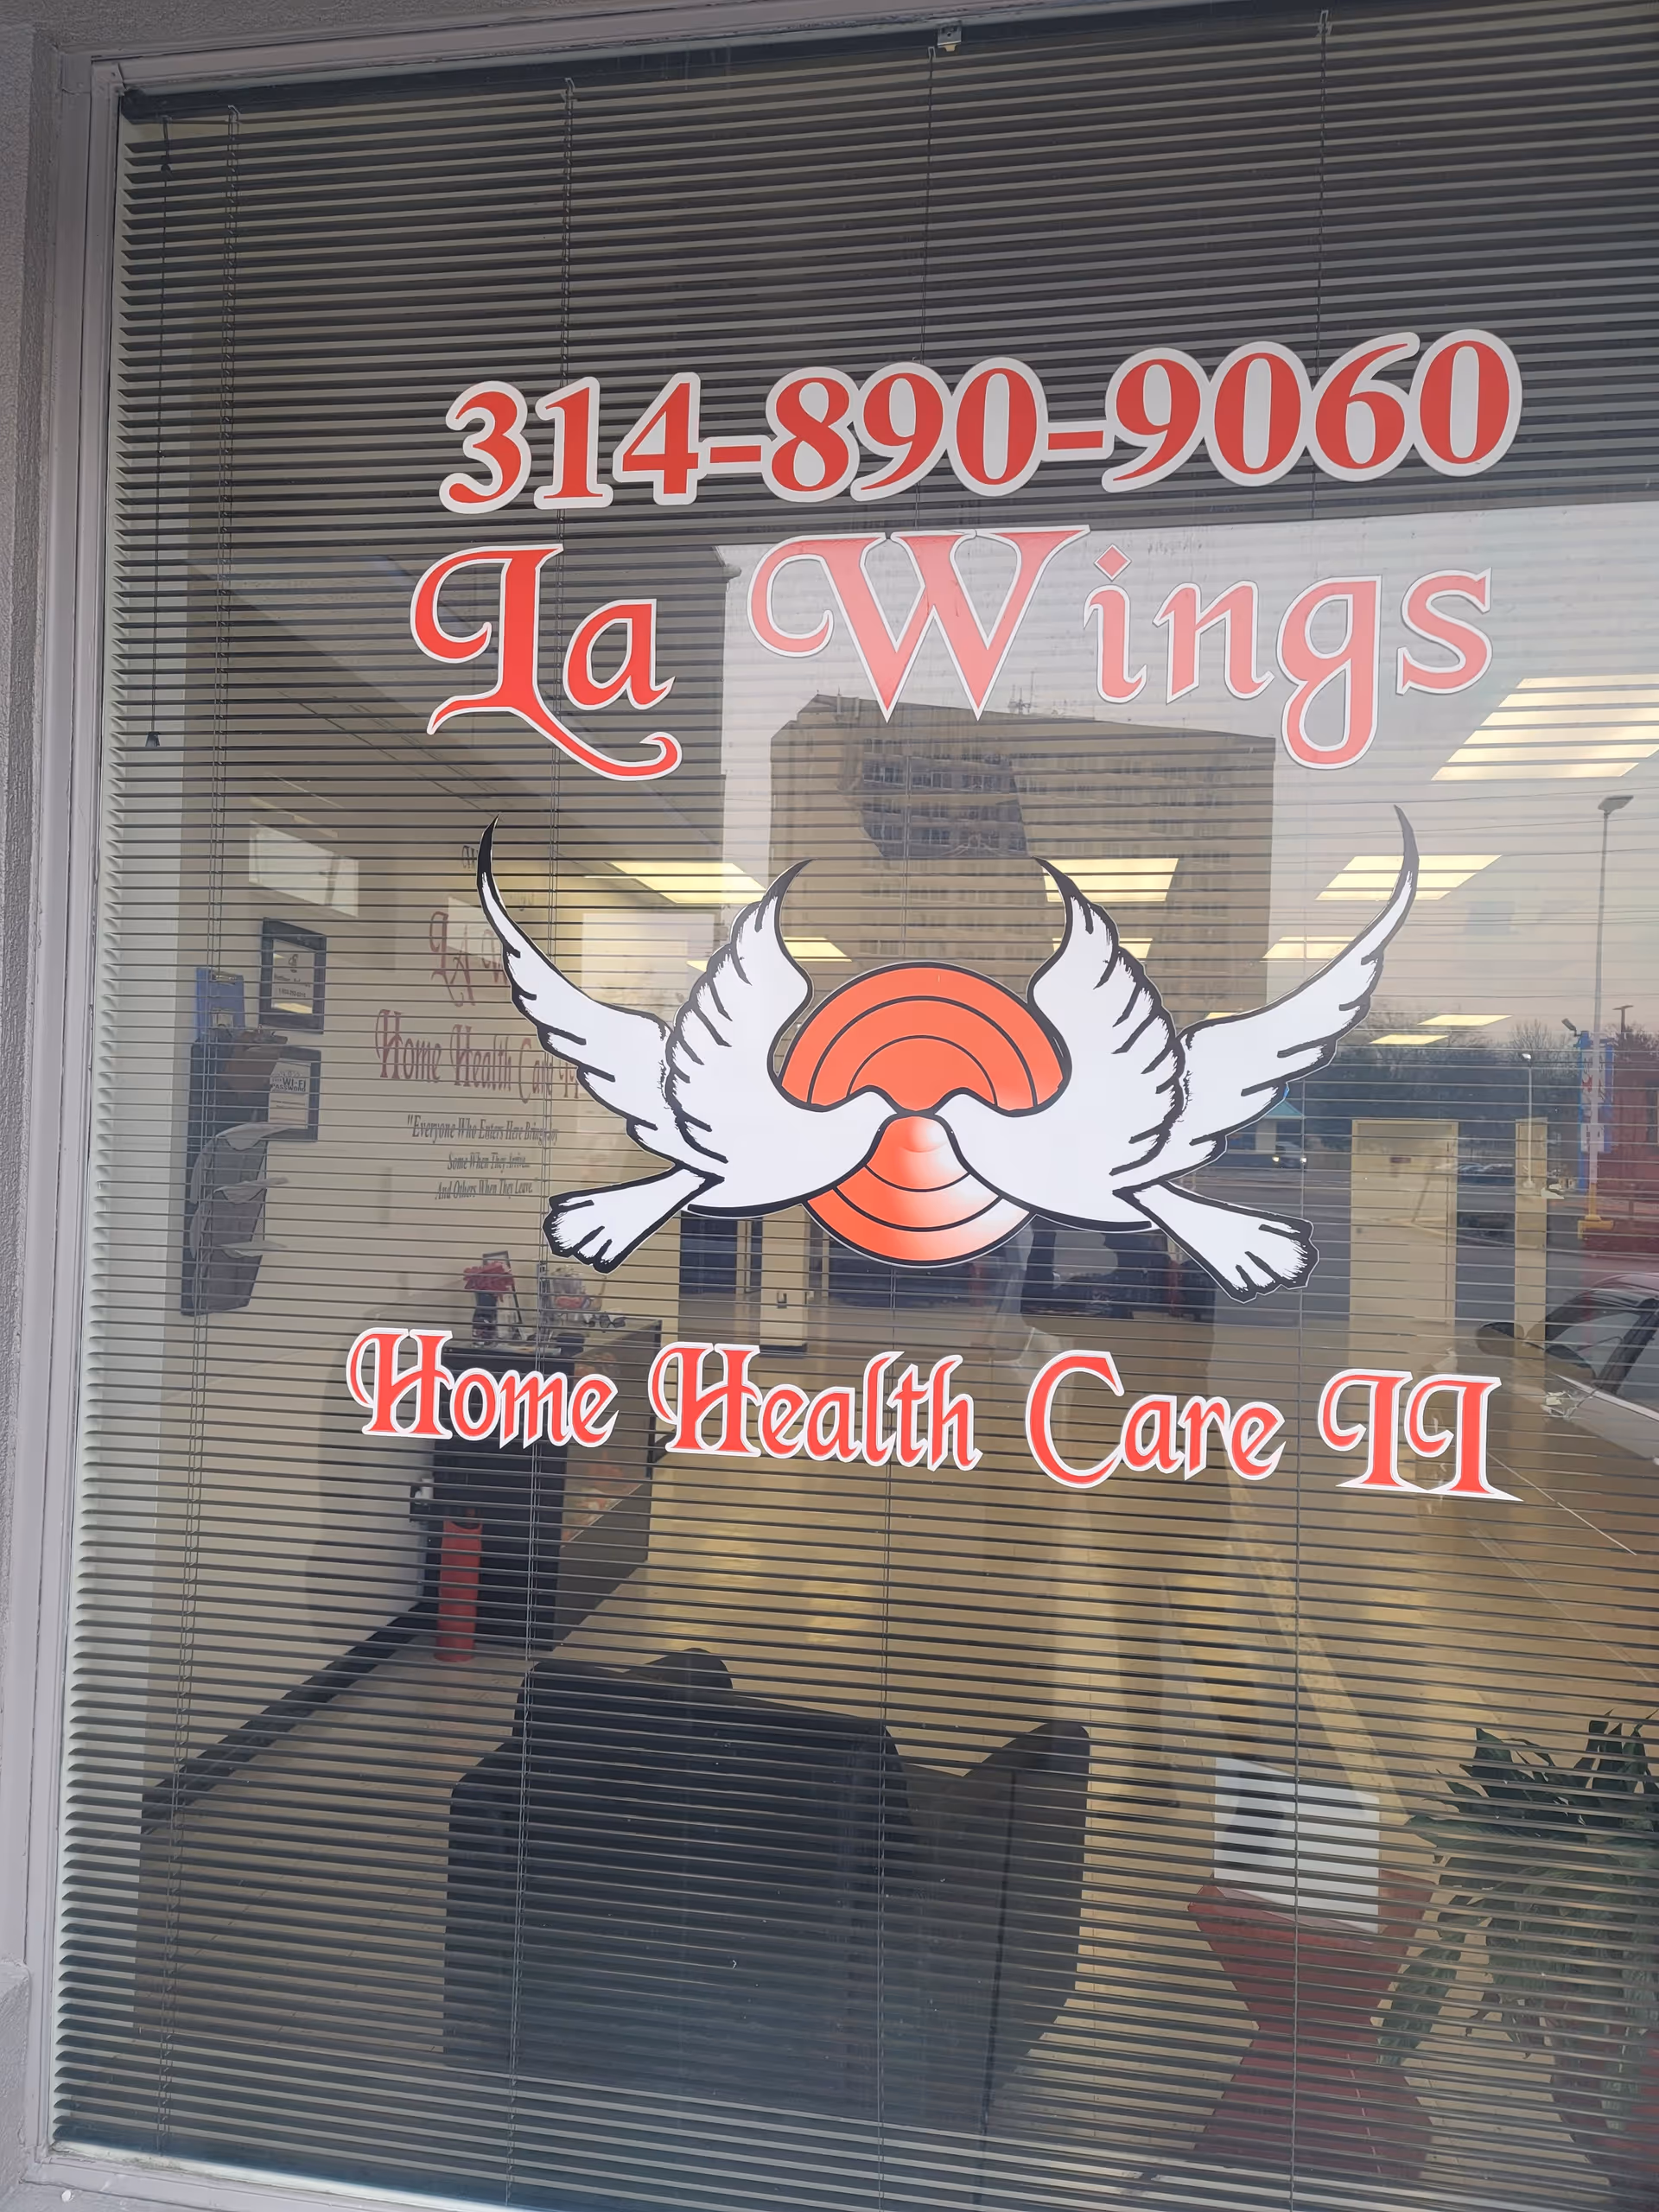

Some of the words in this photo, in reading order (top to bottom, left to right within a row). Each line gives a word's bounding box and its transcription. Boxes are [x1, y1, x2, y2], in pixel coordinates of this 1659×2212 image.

[439, 328, 1522, 513] 314-890-9060
[410, 543, 683, 781] La
[747, 524, 1493, 769] Wings
[283, 1077, 306, 1090] WI-FI
[375, 1009, 441, 1084] Home
[450, 1024, 512, 1092] Health
[519, 1038, 553, 1103] Care
[457, 1117, 477, 1139] Who
[479, 1119, 503, 1140] Enters
[505, 1121, 522, 1140] Here
[524, 1122, 545, 1145] Bring
[435, 1181, 452, 1200] And
[454, 1180, 477, 1199] Others
[479, 1179, 498, 1194] When
[499, 1179, 513, 1199] They
[447, 1151, 467, 1170] Some
[470, 1152, 489, 1169] When
[491, 1152, 506, 1173] They
[346, 1327, 619, 1448] Home
[649, 1341, 982, 1471] Health
[1026, 1350, 1286, 1488] Care
[1318, 1369, 1523, 1501] II
